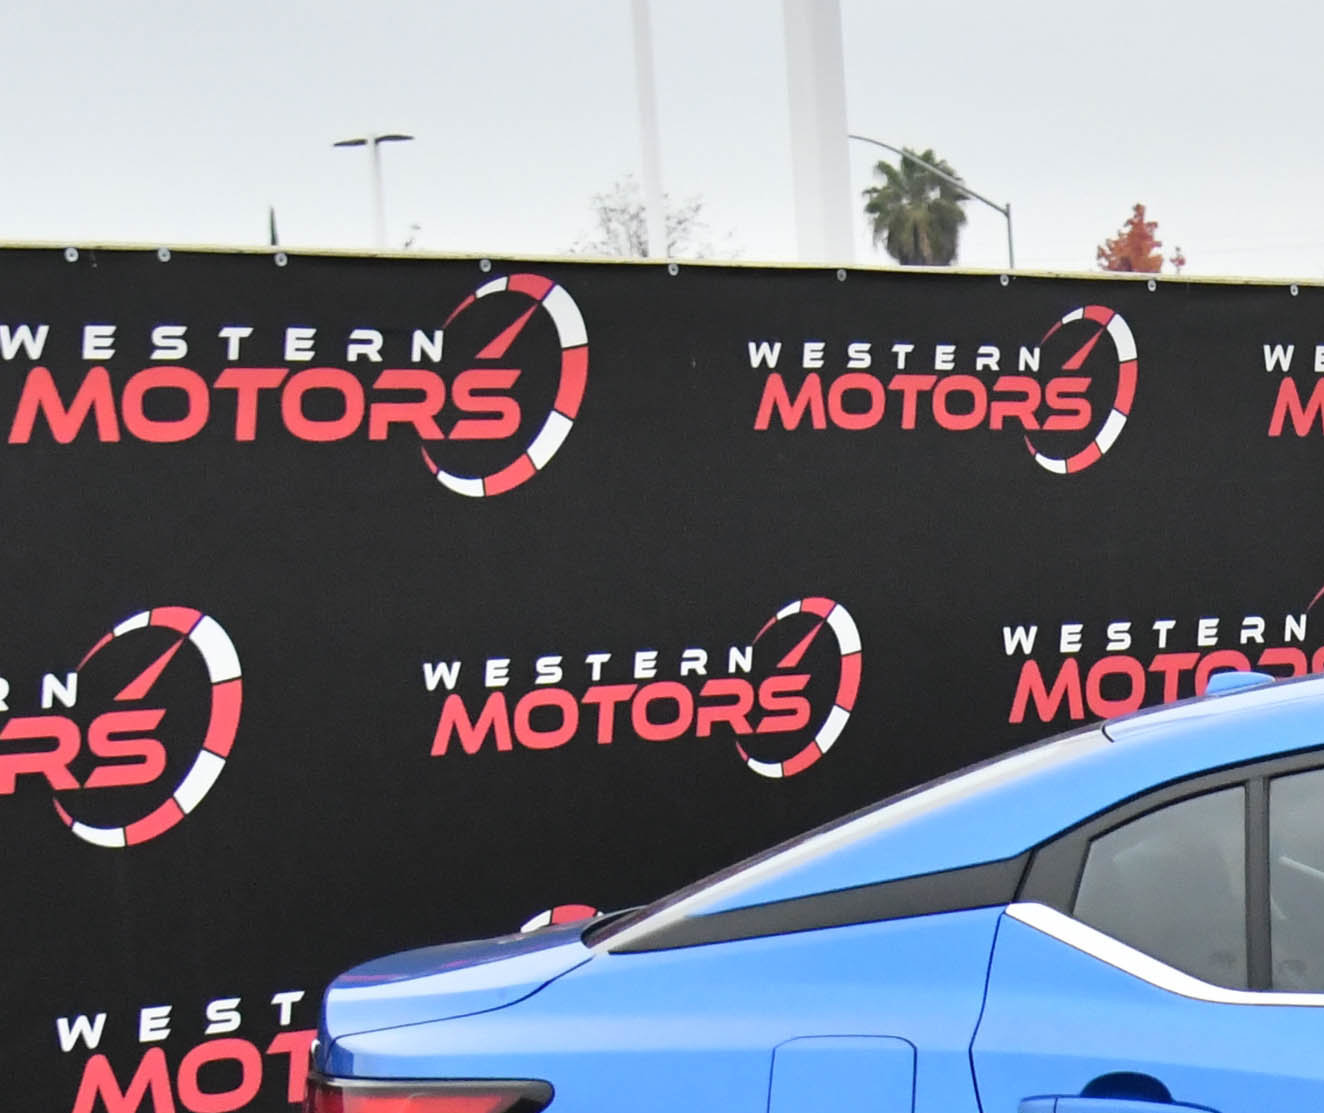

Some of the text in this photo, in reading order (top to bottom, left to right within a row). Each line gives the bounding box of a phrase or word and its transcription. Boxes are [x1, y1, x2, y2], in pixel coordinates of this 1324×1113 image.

[0, 325, 443, 362] WESTERN
[748, 341, 1041, 372] WESTERN
[9, 366, 521, 444] MOTORS
[754, 372, 1092, 431] MOTORS
[1003, 613, 1307, 656] WESTERN
[422, 646, 753, 691] WESTERN
[431, 676, 811, 757] MOTORS
[0, 708, 167, 794] RS
[56, 990, 305, 1052] WEST
